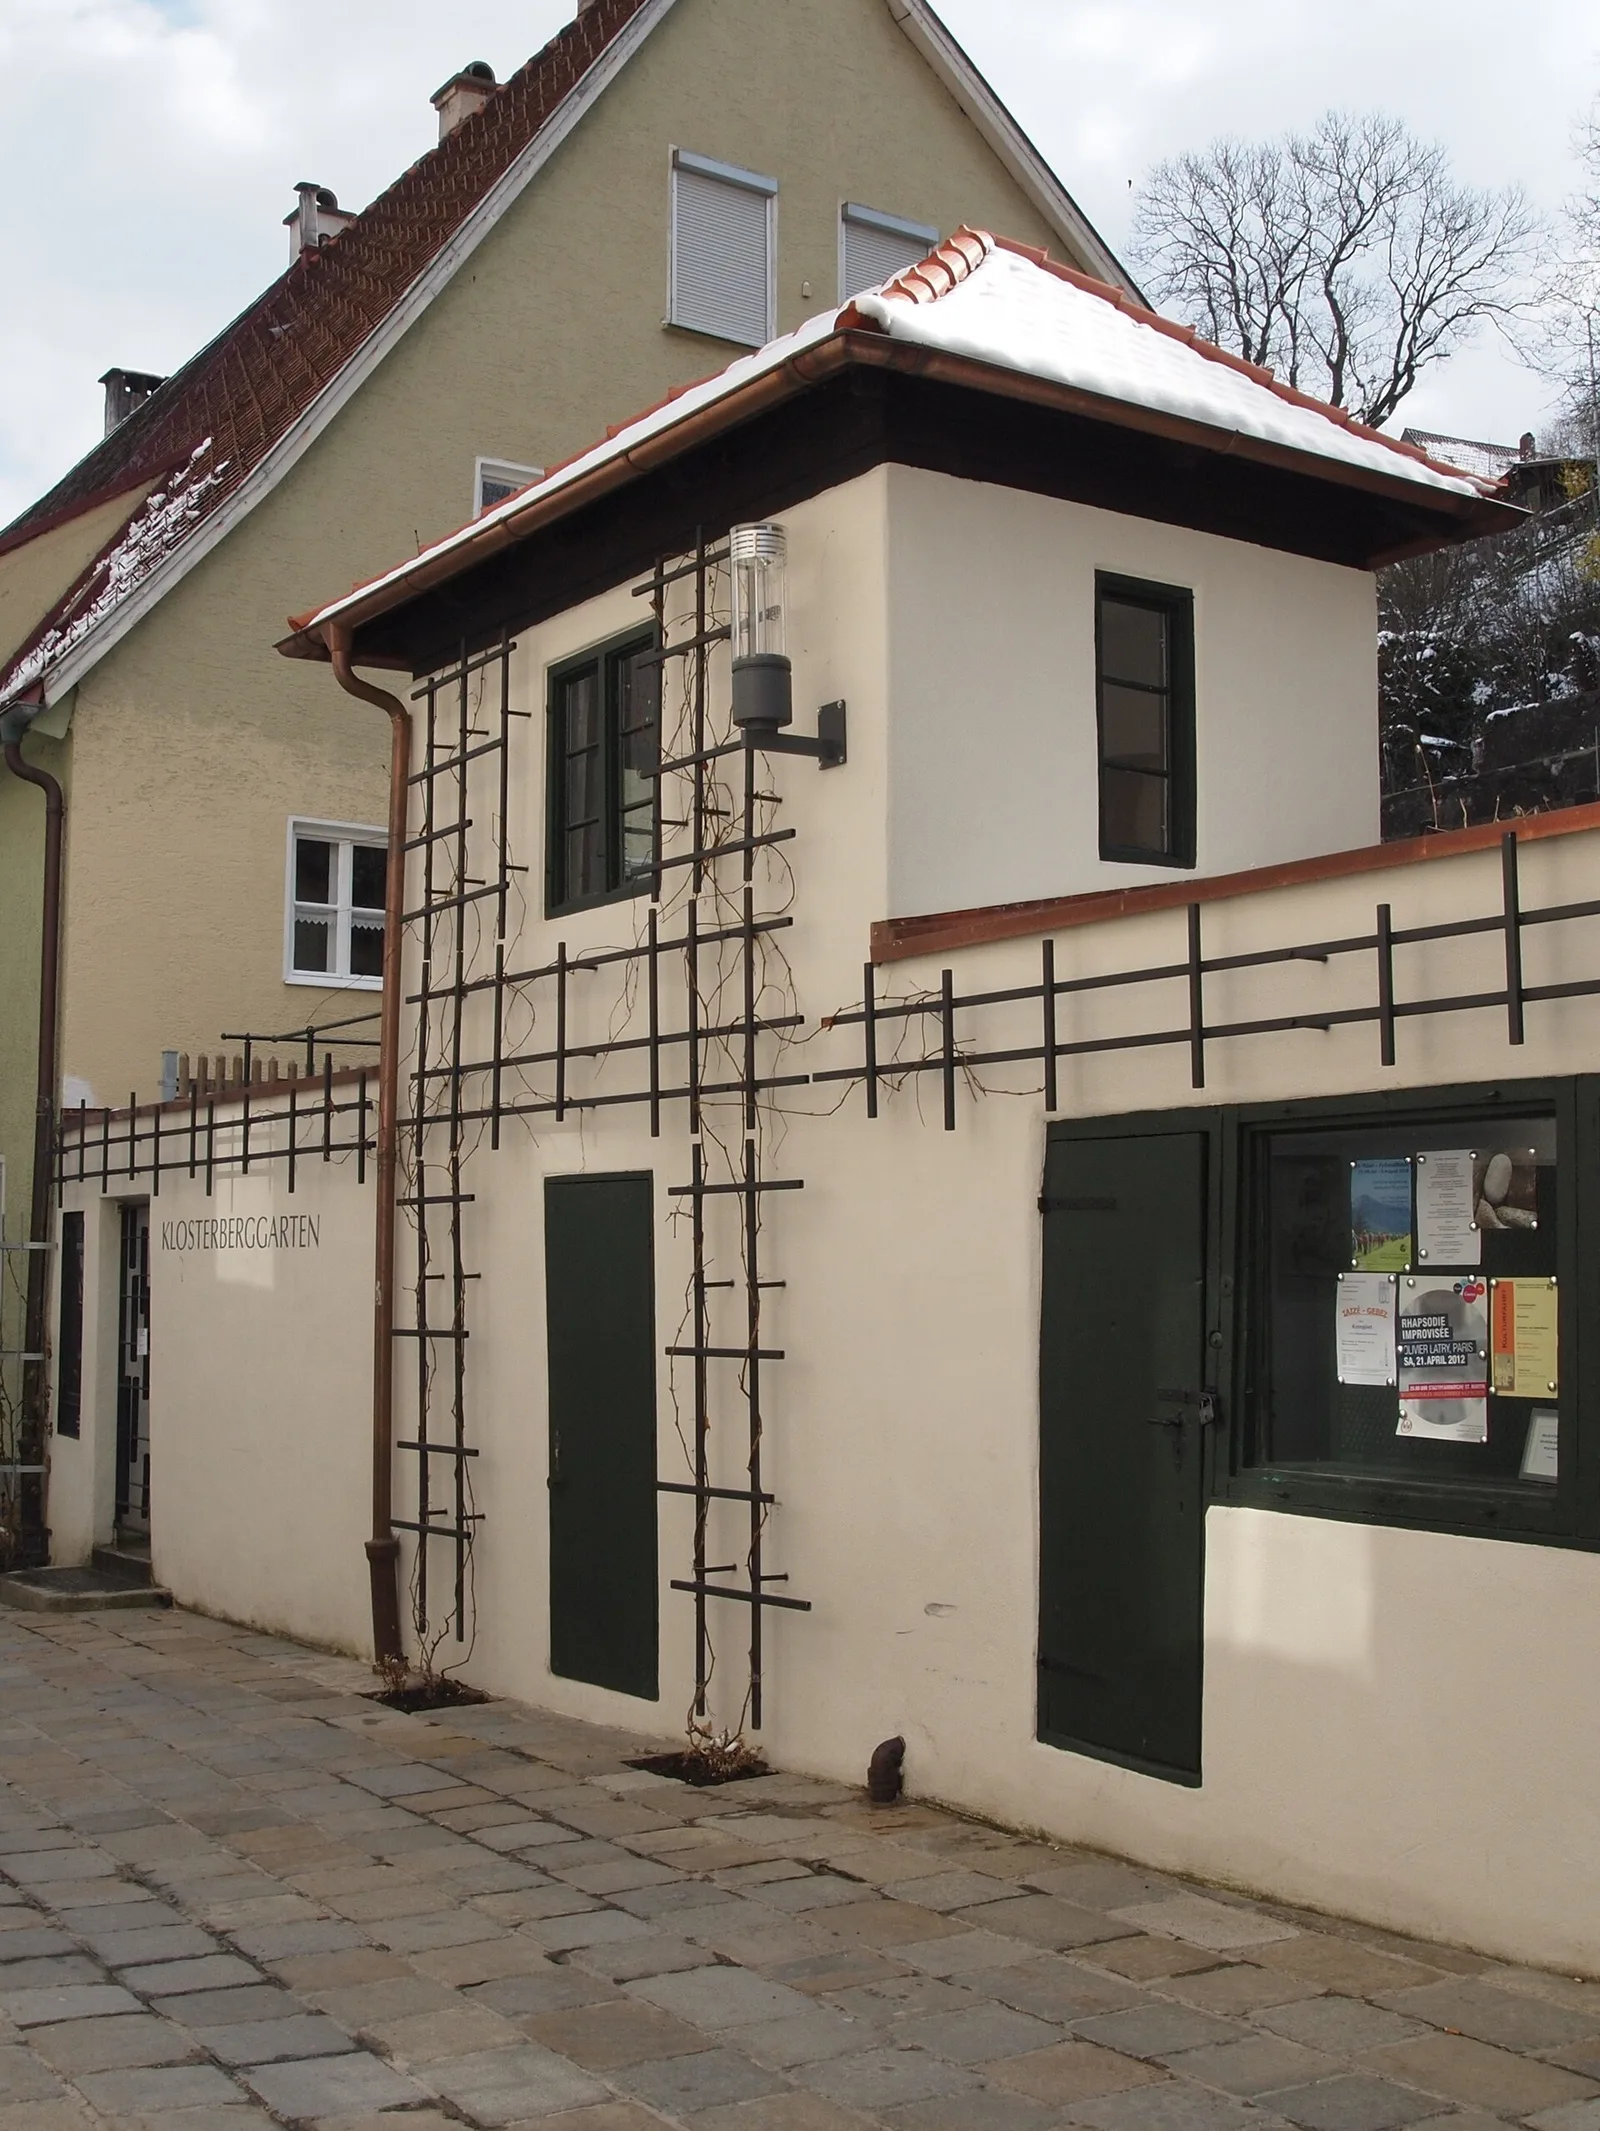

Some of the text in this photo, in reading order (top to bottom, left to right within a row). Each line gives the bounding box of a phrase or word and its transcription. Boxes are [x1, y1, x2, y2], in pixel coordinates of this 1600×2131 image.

[162, 1214, 320, 1251] KLOSTERBERGGARTEN
[1401, 1316, 1446, 1328] RHAPSODIE
[1402, 1327, 1450, 1340] IMPROVISÉE
[1403, 1342, 1474, 1355] OLIVIER LATRY, PARIS
[1403, 1356, 1416, 1367] SA,
[1448, 1354, 1466, 1365] 2012
